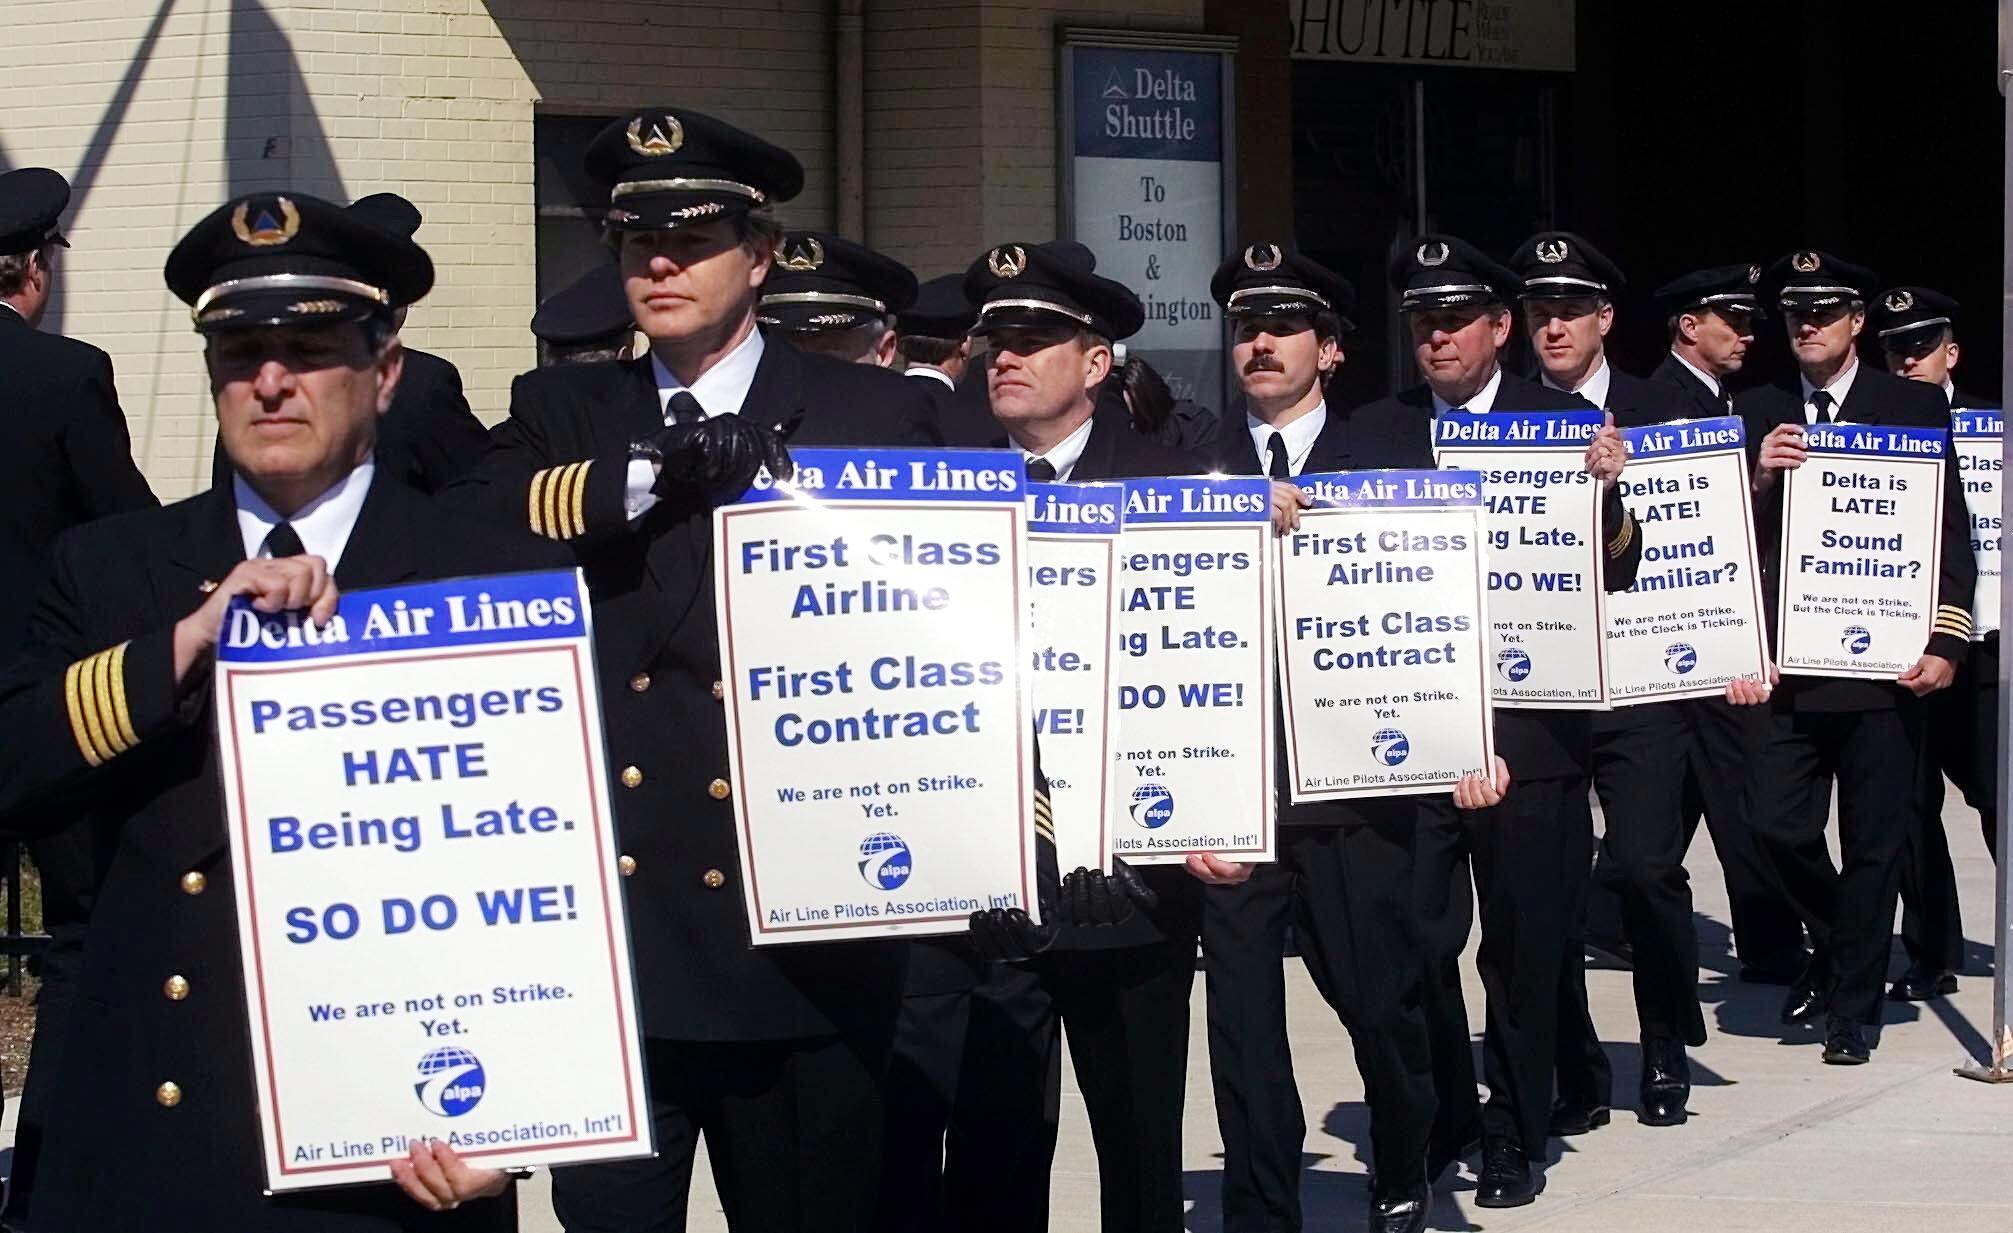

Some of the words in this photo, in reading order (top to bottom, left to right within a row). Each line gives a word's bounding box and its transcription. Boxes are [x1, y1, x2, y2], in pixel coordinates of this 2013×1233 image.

[1289, 0, 1470, 61] HUTTLE
[1135, 68, 1196, 101] Delta
[1105, 104, 1195, 140] Shuttle
[1140, 176, 1166, 202] To
[1118, 214, 1187, 242] Boston
[1145, 254, 1161, 280] &
[1441, 420, 1500, 440] Delta
[1505, 420, 1540, 440] Air
[1545, 420, 1601, 440] Lines
[1976, 417, 2003, 433] Lin
[1640, 433, 1674, 453] Air
[1679, 427, 1739, 449] Lines
[1850, 432, 1883, 450] Air
[1887, 433, 1943, 454] Lines
[1959, 455, 2003, 471] Clas
[835, 460, 898, 490] Air
[909, 460, 1017, 493] Lines
[1618, 476, 1680, 498] Delta
[1688, 473, 1710, 491] is
[1822, 471, 1880, 490] Delta
[1889, 475, 1908, 491] is
[1124, 488, 1172, 514] Air
[1180, 486, 1265, 513] Lines
[1301, 481, 1349, 501] elta
[1356, 479, 1398, 500] Air
[1405, 478, 1477, 500] Lines
[1026, 494, 1115, 524] Lines
[1630, 500, 1701, 524] LATE!
[1831, 497, 1896, 516] LATE!
[1292, 532, 1367, 556] First
[1378, 530, 1467, 552] Class
[1519, 526, 1584, 546] Late.
[1645, 535, 1714, 562] ound
[1821, 529, 1903, 552] Sound
[741, 536, 849, 575] First
[867, 534, 1001, 566] Class
[1800, 554, 1921, 579] Familiar?
[1327, 561, 1434, 586] Airline
[1488, 571, 1523, 591] DO
[1532, 573, 1582, 592] WE!
[1624, 562, 1738, 594] amiliar?
[791, 580, 950, 619] Airline
[1793, 604, 1812, 613] But
[1814, 605, 1831, 614] the
[1834, 606, 1863, 616] Clock
[1866, 608, 1876, 616] is
[1880, 609, 1921, 620] Ticking.
[1802, 593, 1819, 603] We
[1821, 596, 1838, 604] are
[1841, 596, 1859, 605] not
[1862, 597, 1874, 605] on
[1877, 597, 1912, 608] Strike.
[227, 609, 350, 649] Delta
[363, 602, 434, 639] Air
[445, 593, 576, 634] Lines
[1296, 615, 1370, 640] First
[1381, 611, 1470, 635] Class
[1494, 621, 1514, 630] not
[1536, 621, 1577, 631] Strike.
[1606, 630, 1625, 639] But
[1629, 627, 1648, 637] the
[1651, 623, 1684, 634] Clock
[1687, 622, 1698, 630] is
[1700, 617, 1747, 630] Ticking.
[1614, 617, 1632, 627] We
[1636, 616, 1655, 624] are
[1658, 612, 1677, 621] not
[1681, 611, 1694, 619] on
[1698, 606, 1736, 617] Strike.
[1161, 625, 1248, 649] Late.
[1500, 633, 1524, 643] Yet.
[1033, 646, 1091, 672] te.
[1313, 642, 1456, 671] Contract
[1787, 656, 1800, 664] Air
[1802, 657, 1822, 666] Line
[1823, 657, 1849, 667] Pilots
[1851, 659, 1905, 670] Association,
[749, 661, 853, 701] First
[870, 655, 1003, 691] Class
[1609, 687, 1623, 696] Air
[1625, 685, 1646, 694] Line
[1649, 682, 1676, 692] Pilots
[1118, 684, 1166, 710] DO
[1178, 683, 1244, 708] WE!
[1314, 698, 1334, 708] We
[1339, 697, 1361, 707] are
[1366, 694, 1388, 705] not
[1392, 694, 1408, 703] on
[1413, 691, 1458, 702] Strike.
[1493, 688, 1508, 696] ots
[1511, 688, 1575, 699] Association,
[1578, 689, 1597, 698] Int'l
[250, 685, 563, 734] Passengers
[1374, 709, 1400, 719] Yet.
[774, 701, 980, 748] Contract
[343, 742, 488, 787] HATE
[1127, 749, 1152, 760] not
[1158, 750, 1177, 760] on
[1182, 747, 1235, 759] Strike.
[1136, 765, 1166, 777] Yet.
[1305, 778, 1321, 788] Air
[1325, 775, 1350, 787] Line
[1353, 772, 1385, 784] Pilots
[1389, 769, 1459, 783] Association,
[777, 787, 806, 803] We
[812, 785, 842, 800] are
[849, 782, 881, 798] not
[887, 781, 910, 795] on
[917, 774, 983, 792] Strike.
[861, 803, 899, 819] Yet.
[1146, 808, 1170, 819] alpa
[268, 811, 421, 854] Being
[441, 801, 575, 840] Late.
[1115, 838, 1143, 849] ilots
[1147, 836, 1229, 849] Association,
[1233, 835, 1258, 846] Int'l
[880, 863, 909, 879] alpa
[286, 903, 360, 944] SO
[382, 894, 458, 935] DO
[476, 884, 577, 926] WE!
[769, 909, 791, 924] Air
[795, 905, 830, 922] Line
[835, 901, 880, 919] Pilots
[988, 892, 1017, 909] Int'l
[308, 1004, 346, 1023] We
[355, 998, 396, 1018] are
[405, 993, 445, 1013] not
[454, 990, 483, 1009] on
[492, 984, 574, 1005] Strike.
[419, 1020, 469, 1038] Yet.
[443, 1083, 482, 1103] alpa
[293, 1143, 323, 1162] Air
[330, 1140, 374, 1160] Line
[447, 1120, 580, 1147] Association,
[585, 1115, 623, 1135] Int'l
